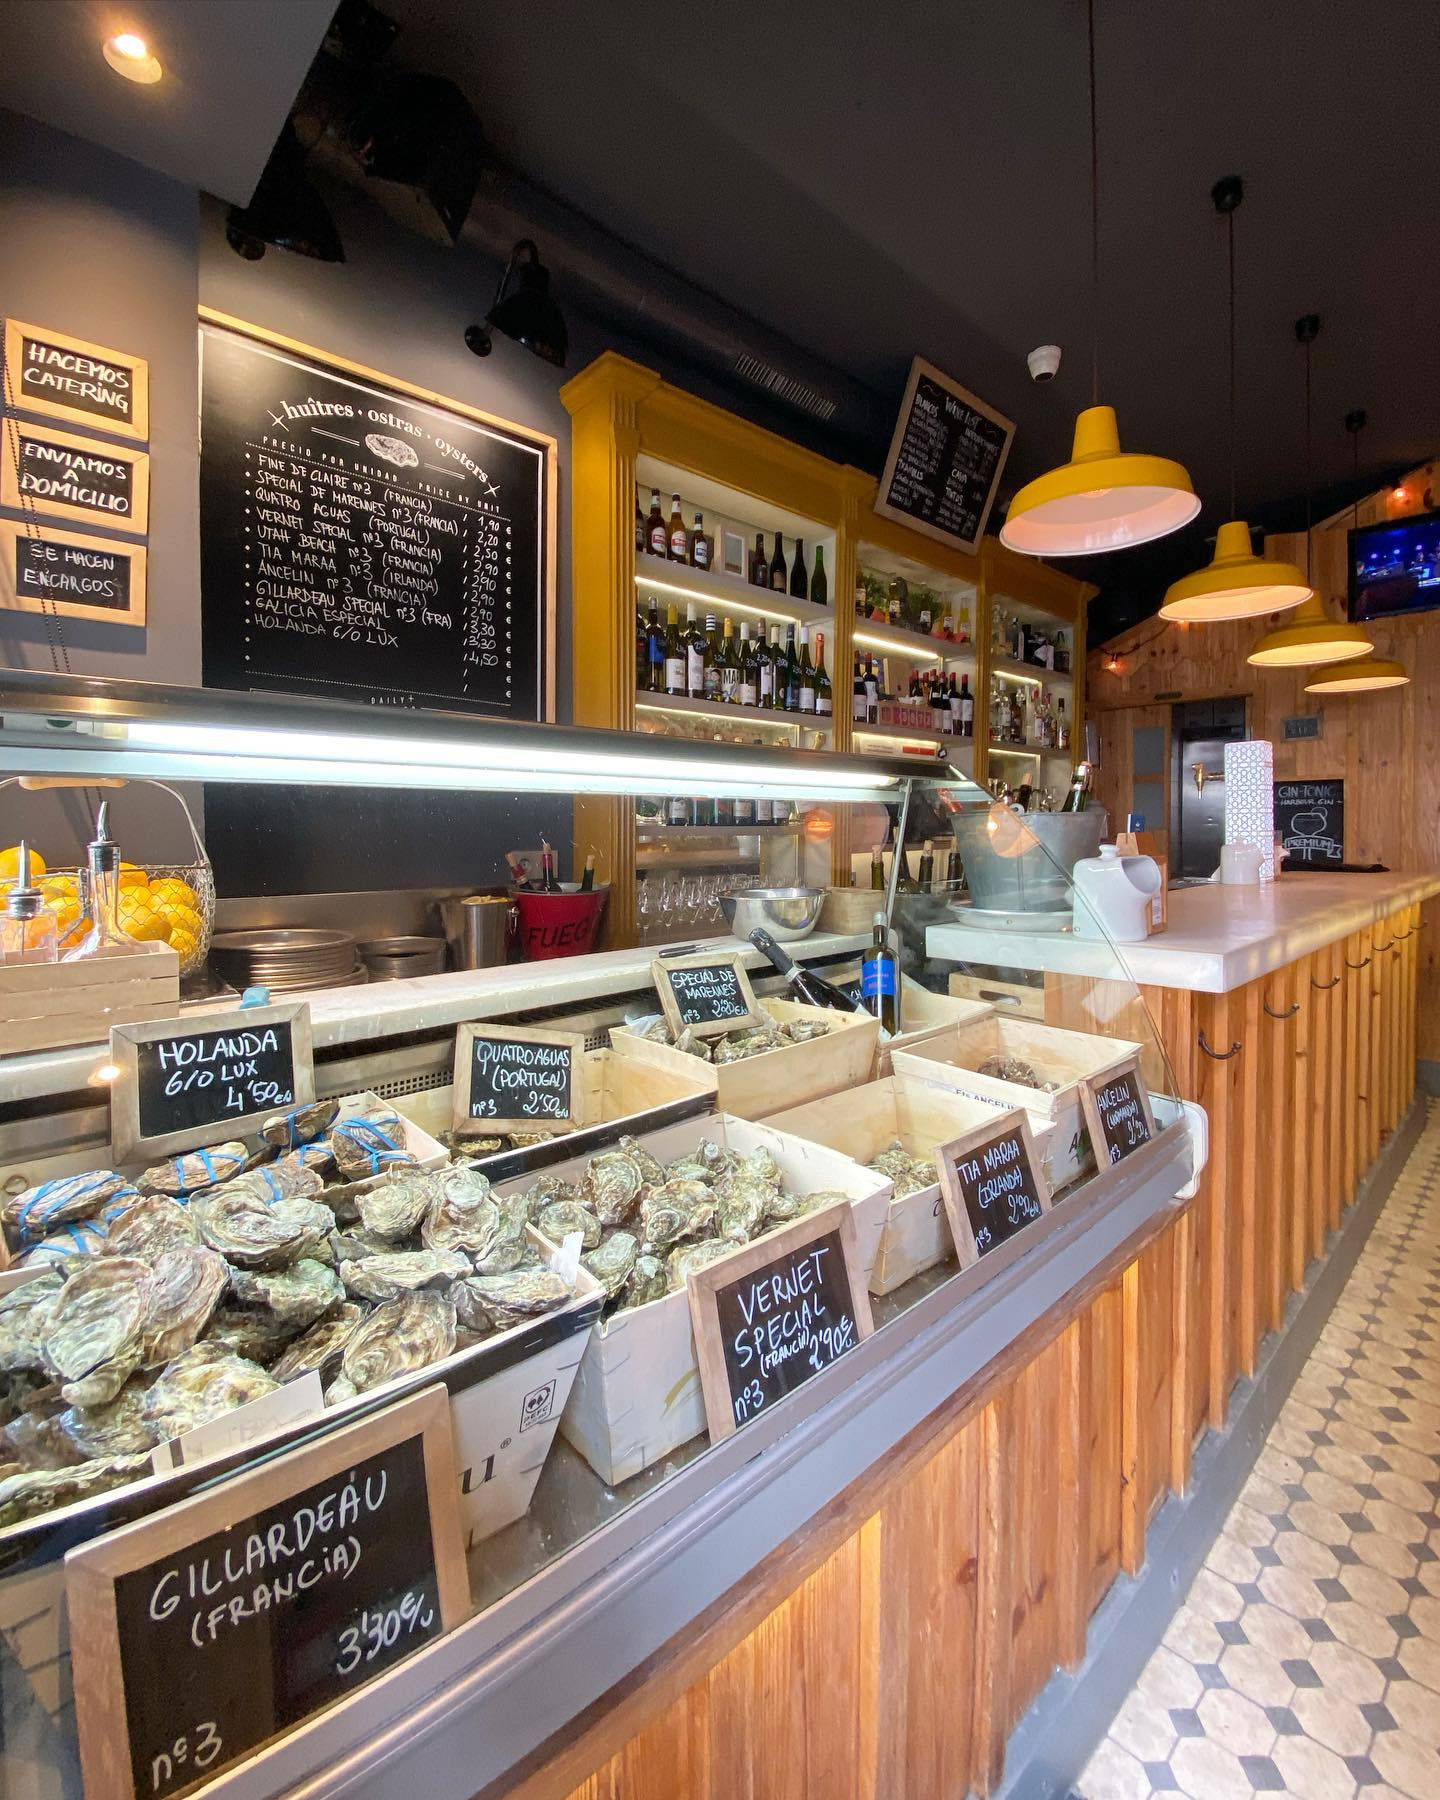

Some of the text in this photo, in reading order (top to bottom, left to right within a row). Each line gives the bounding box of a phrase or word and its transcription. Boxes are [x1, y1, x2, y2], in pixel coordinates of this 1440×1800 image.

[24, 367, 129, 413] CATERING
[28, 343, 130, 389] HACEMOS
[24, 443, 127, 480] ENVIAMOS
[280, 398, 489, 484] huîtres ostras oysters
[21, 473, 129, 513] DOMICILIO
[63, 469, 80, 483] A
[259, 454, 286, 471] FINE
[290, 463, 307, 476] DE
[310, 470, 350, 489] CLAIRE
[384, 488, 433, 515] (FRANCIA)
[263, 435, 500, 513] PRECIO POR UNIDAD PRICE BY UNIT
[255, 470, 303, 493] SPECIAL
[310, 485, 327, 499] DE
[332, 490, 387, 516] MARENNES
[413, 510, 459, 537] (FRANCIA)
[255, 487, 301, 511] QUATRO
[313, 502, 351, 524] AGUAS
[368, 514, 430, 548] (PORTUGAL)
[31, 543, 115, 571] SE HACEN
[256, 506, 304, 530] VERNET
[312, 520, 356, 542] SPECIAL
[390, 535, 442, 565] (FRANCIA)
[257, 524, 291, 543] UTAH
[298, 533, 337, 553] BEACH
[382, 551, 434, 577] (FRANCIA)
[24, 567, 115, 597] ENCARGOS
[257, 541, 282, 561] TIA
[291, 550, 337, 574] MARAA
[382, 567, 439, 597] (IRLANDA)
[257, 559, 315, 585] ANCELIN
[367, 581, 427, 609] (FRANCIA)
[255, 597, 318, 620] GALICIA
[322, 608, 386, 631] ESPECIAL
[256, 580, 335, 608] GILLARDEAU
[342, 595, 391, 619] SPECIAL
[421, 607, 452, 630] (FRA)
[254, 613, 327, 636] HOLANDA
[366, 631, 399, 648] LUX
[671, 970, 737, 989] SPECIAL DE
[158, 1029, 279, 1070] HOLANDA
[220, 1059, 259, 1082] LUX
[491, 1064, 567, 1092] (PORTUGAL)
[957, 1139, 1020, 1185] TIA MARAA
[737, 1247, 830, 1326] VERNET
[734, 1293, 826, 1368] SPECIAL
[760, 1325, 811, 1379] (FRANCIA)
[149, 1468, 388, 1622] GILLARDEAU
[190, 1536, 361, 1648] (FRANCIA)
